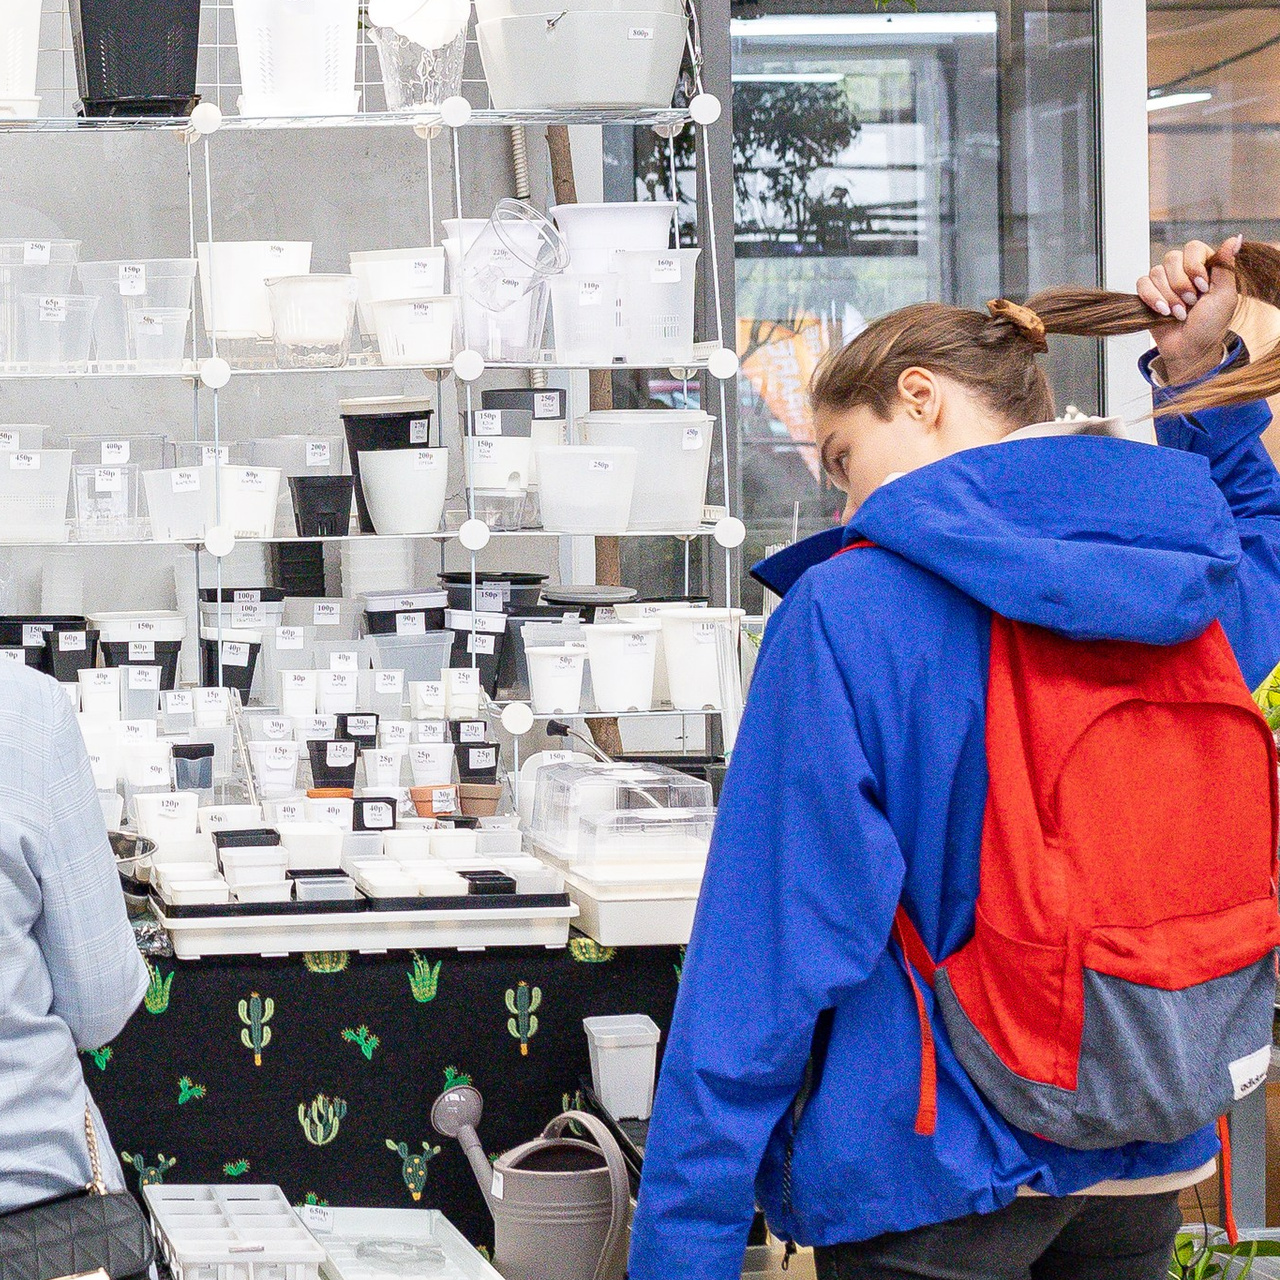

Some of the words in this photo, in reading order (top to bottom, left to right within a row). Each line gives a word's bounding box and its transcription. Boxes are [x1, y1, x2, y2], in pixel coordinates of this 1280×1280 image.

[632, 28, 649, 38] 800р
[123, 266, 140, 274] 150р
[413, 303, 429, 311] 100р
[480, 413, 496, 421] 150р
[311, 444, 326, 452] 200р
[478, 440, 493, 448] 150р
[15, 454, 32, 462] 450р
[98, 470, 115, 478] 250р
[246, 471, 258, 479] 80р
[238, 592, 254, 600] 100р
[481, 591, 498, 599] 150р
[401, 600, 413, 608] 90р
[403, 615, 415, 623] 90р
[282, 629, 295, 637] 60р
[64, 634, 77, 642] 60р
[632, 634, 644, 642] 90р
[134, 643, 147, 651] 80р
[228, 644, 241, 652] 40р
[5, 651, 18, 660] 70р
[338, 653, 350, 661] 40р
[560, 656, 572, 664] 50р
[136, 669, 150, 677] 40р
[458, 672, 470, 680] 25р
[293, 674, 306, 682] 30р
[333, 674, 346, 682] 20р
[383, 674, 395, 682] 20р
[173, 693, 185, 701] 15р
[271, 721, 284, 729] 30р
[314, 719, 326, 727] 30р
[391, 726, 404, 734] 20р
[425, 724, 438, 732] 20р
[467, 724, 479, 732] 20р
[336, 744, 348, 752] 15р
[418, 751, 430, 759] 25р
[478, 750, 490, 758] 25р
[549, 753, 565, 761] 150р
[150, 766, 162, 774] 50р
[161, 800, 180, 808] 120р
[282, 806, 295, 814] 40р
[326, 806, 340, 814] 40р
[369, 805, 383, 813] 40р
[310, 1208, 328, 1216] 650р
